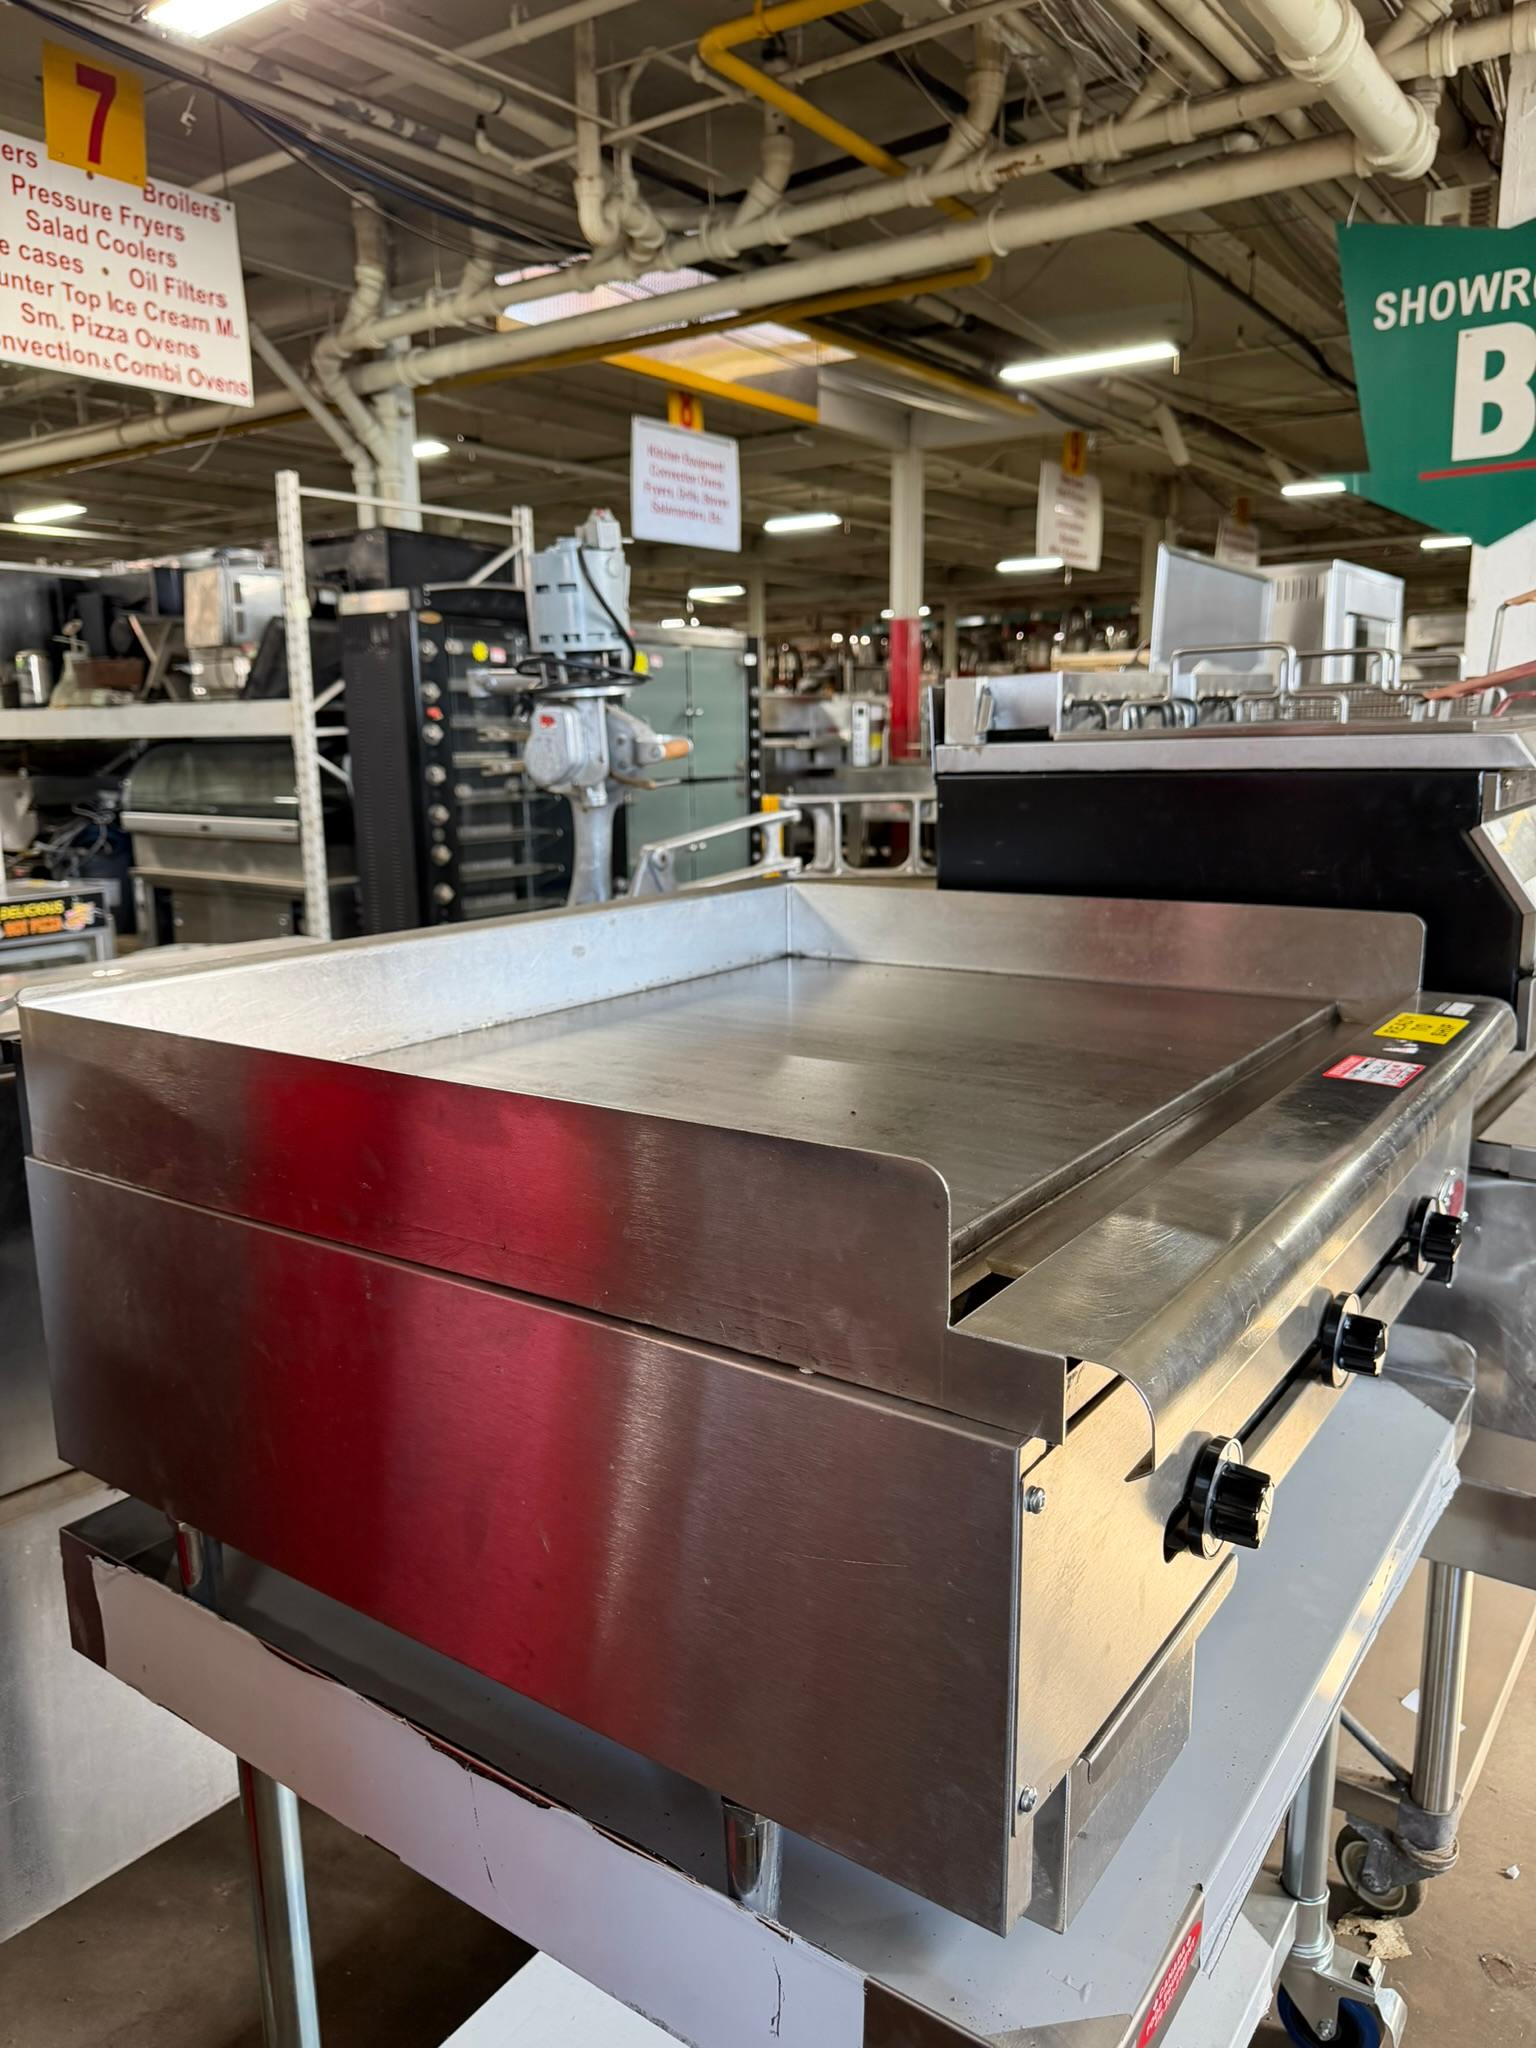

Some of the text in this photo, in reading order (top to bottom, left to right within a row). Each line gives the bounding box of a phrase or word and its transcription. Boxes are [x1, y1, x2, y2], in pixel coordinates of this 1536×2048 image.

[75, 62, 117, 166] 7
[1, 143, 222, 225] ers Broilers
[11, 173, 186, 244] Pressure Fryers
[25, 208, 178, 269] Salad Coolers
[18, 244, 84, 274] cases
[128, 267, 159, 293] Oil
[164, 276, 229, 310] Filters
[61, 281, 101, 312] Top
[107, 290, 138, 317] Ice
[143, 301, 210, 334] Cream
[1372, 267, 1536, 332] SHOWR
[20, 302, 201, 361] Sm. Pizza Ovens
[0, 334, 100, 367] nvection
[113, 352, 183, 386] Combi
[186, 366, 250, 398] Ovens
[1451, 321, 1536, 463] B
